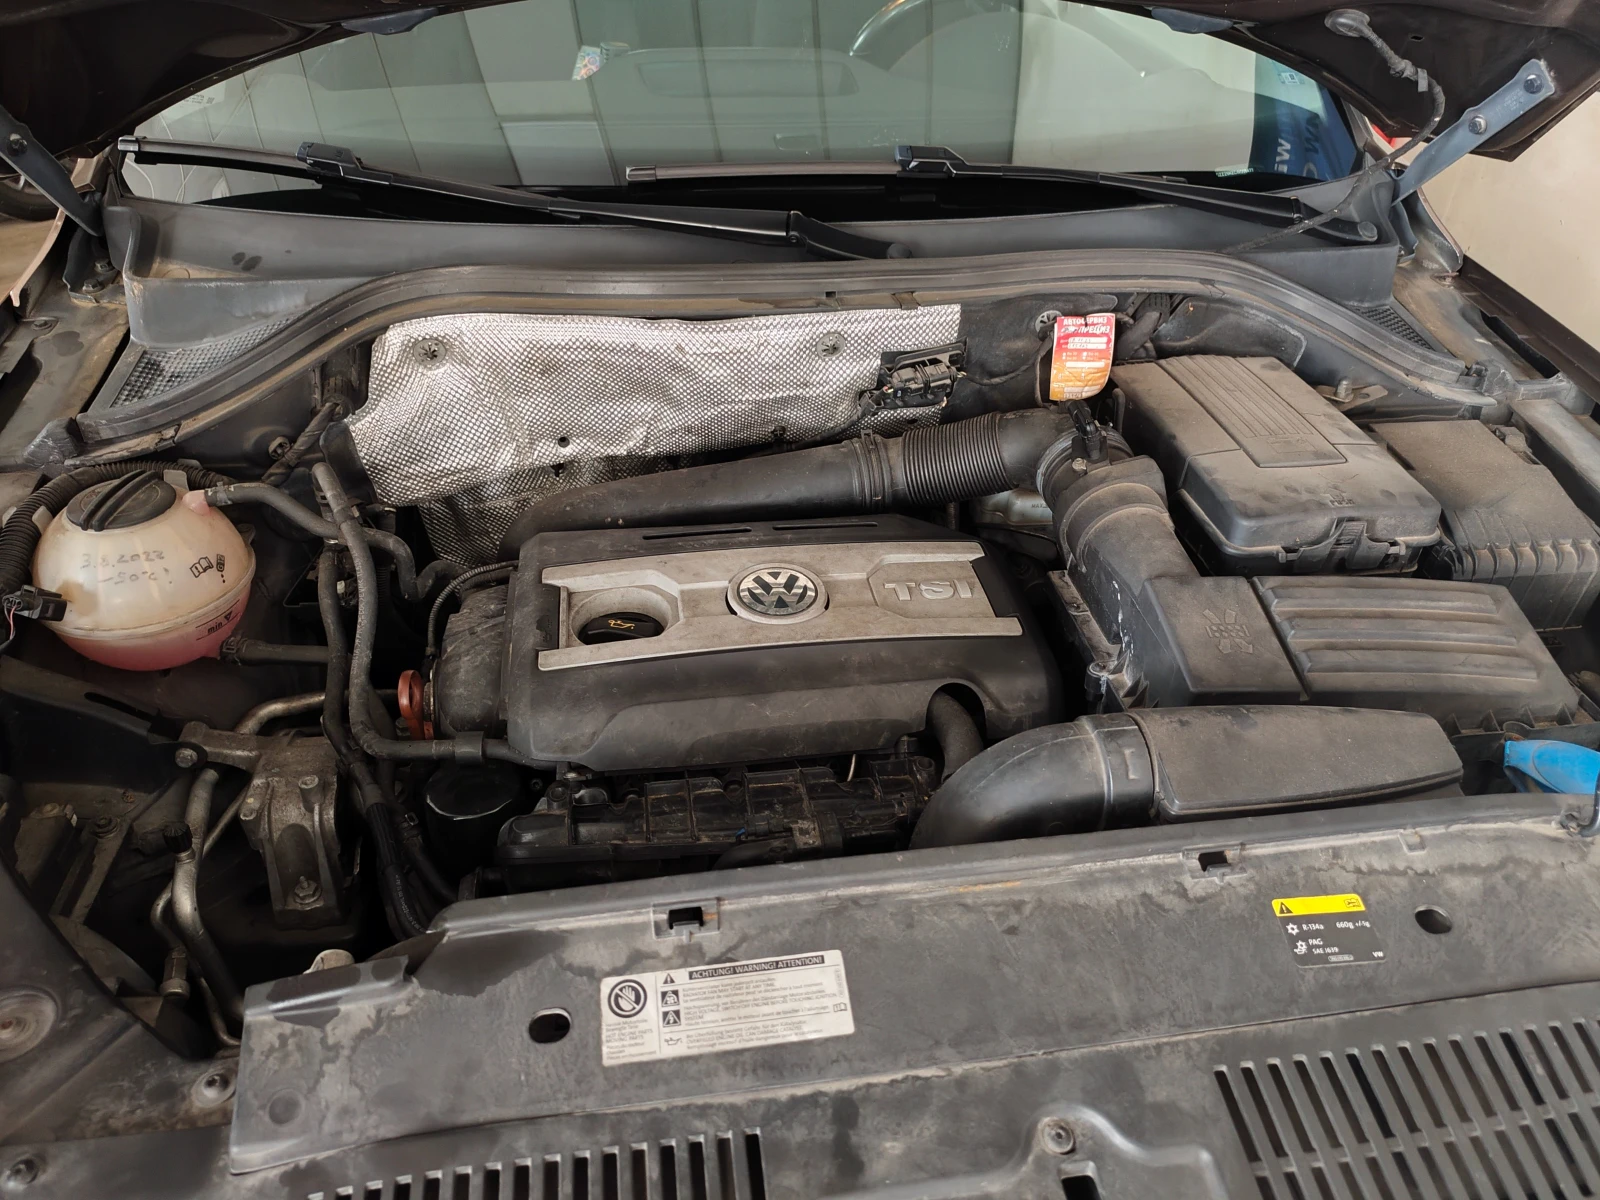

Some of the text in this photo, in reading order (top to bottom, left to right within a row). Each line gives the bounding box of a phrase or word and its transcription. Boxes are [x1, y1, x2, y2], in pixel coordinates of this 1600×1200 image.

[882, 580, 972, 601] TSI
[207, 621, 223, 634] min
[1302, 923, 1324, 931] R-134a
[1336, 921, 1354, 930] 660g
[692, 956, 822, 979] ACHTUNG! WARNING! ATTENTION!
